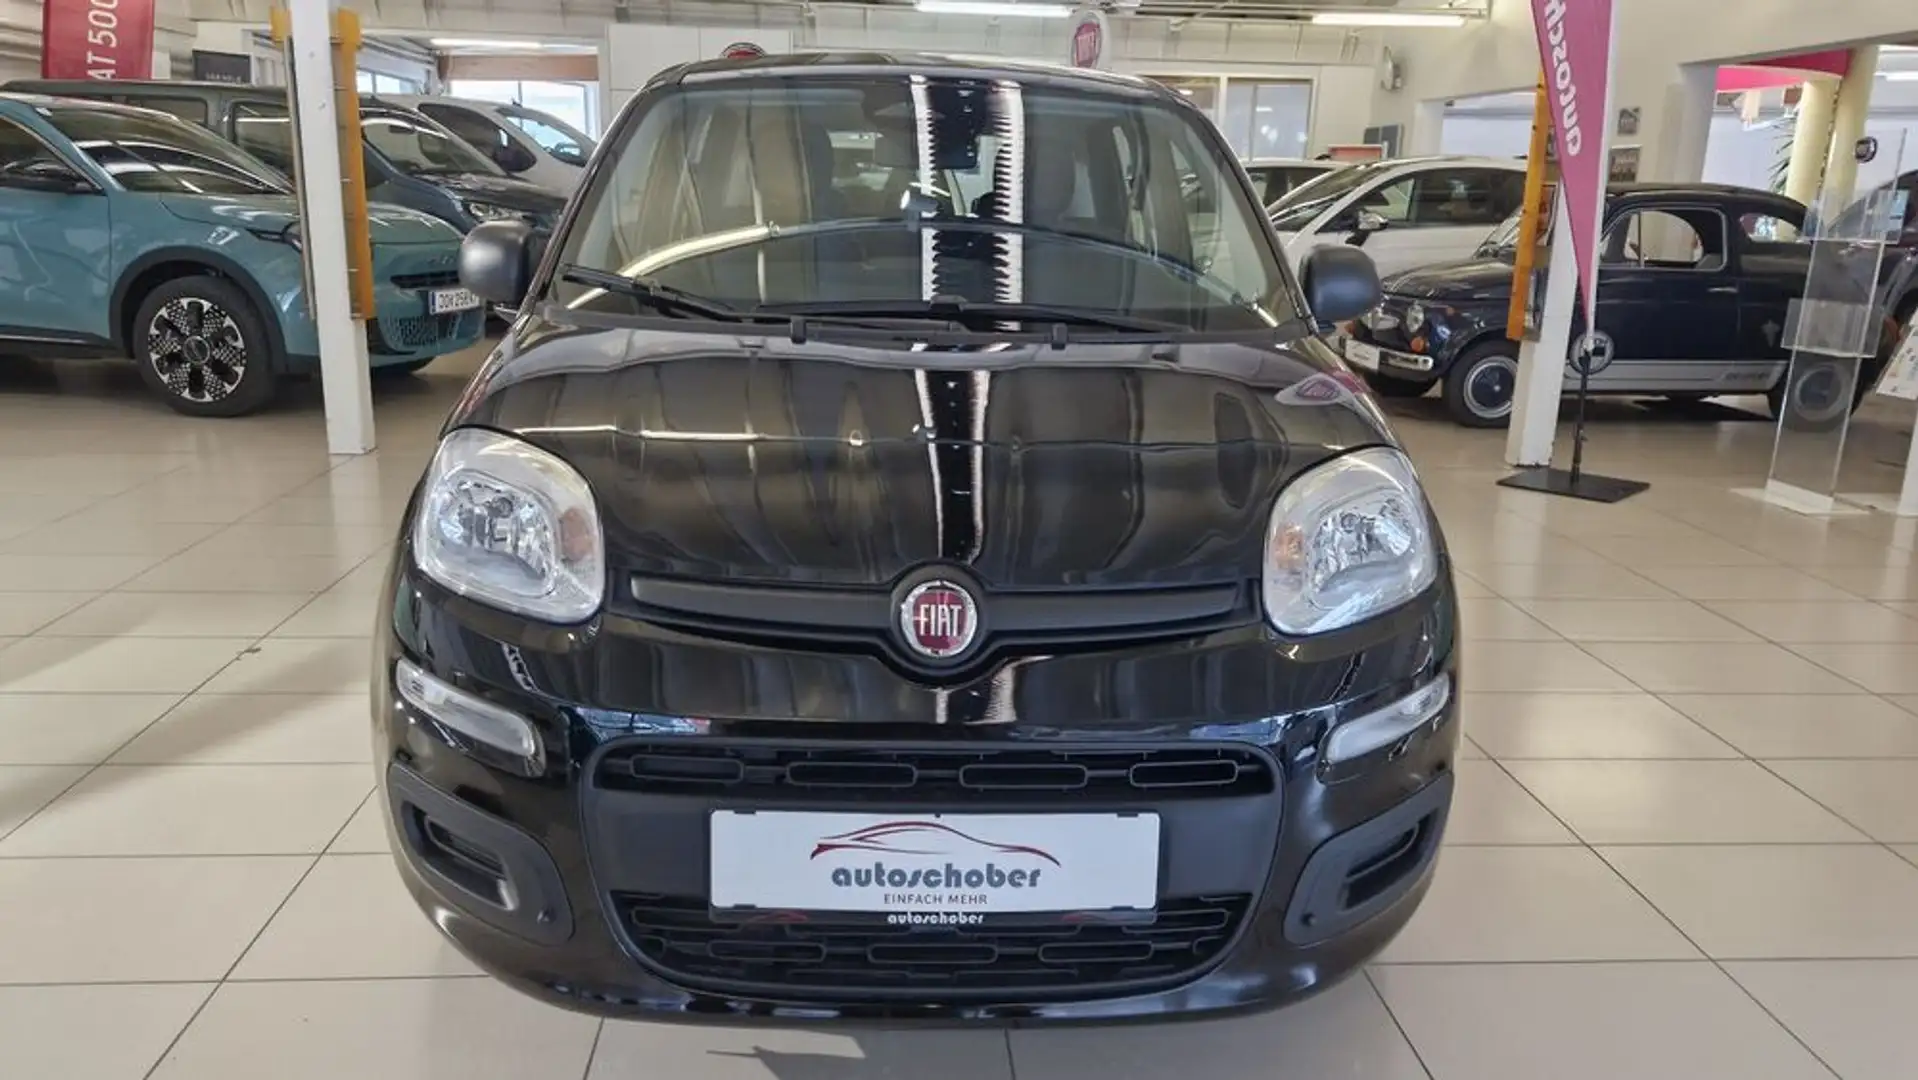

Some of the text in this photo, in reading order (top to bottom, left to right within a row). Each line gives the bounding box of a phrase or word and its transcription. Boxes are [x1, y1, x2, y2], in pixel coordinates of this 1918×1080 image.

[919, 603, 962, 637] FIAT
[831, 861, 1041, 888] autoschober
[883, 893, 988, 905] EINFACH MEHR
[886, 911, 984, 925] autoschober
